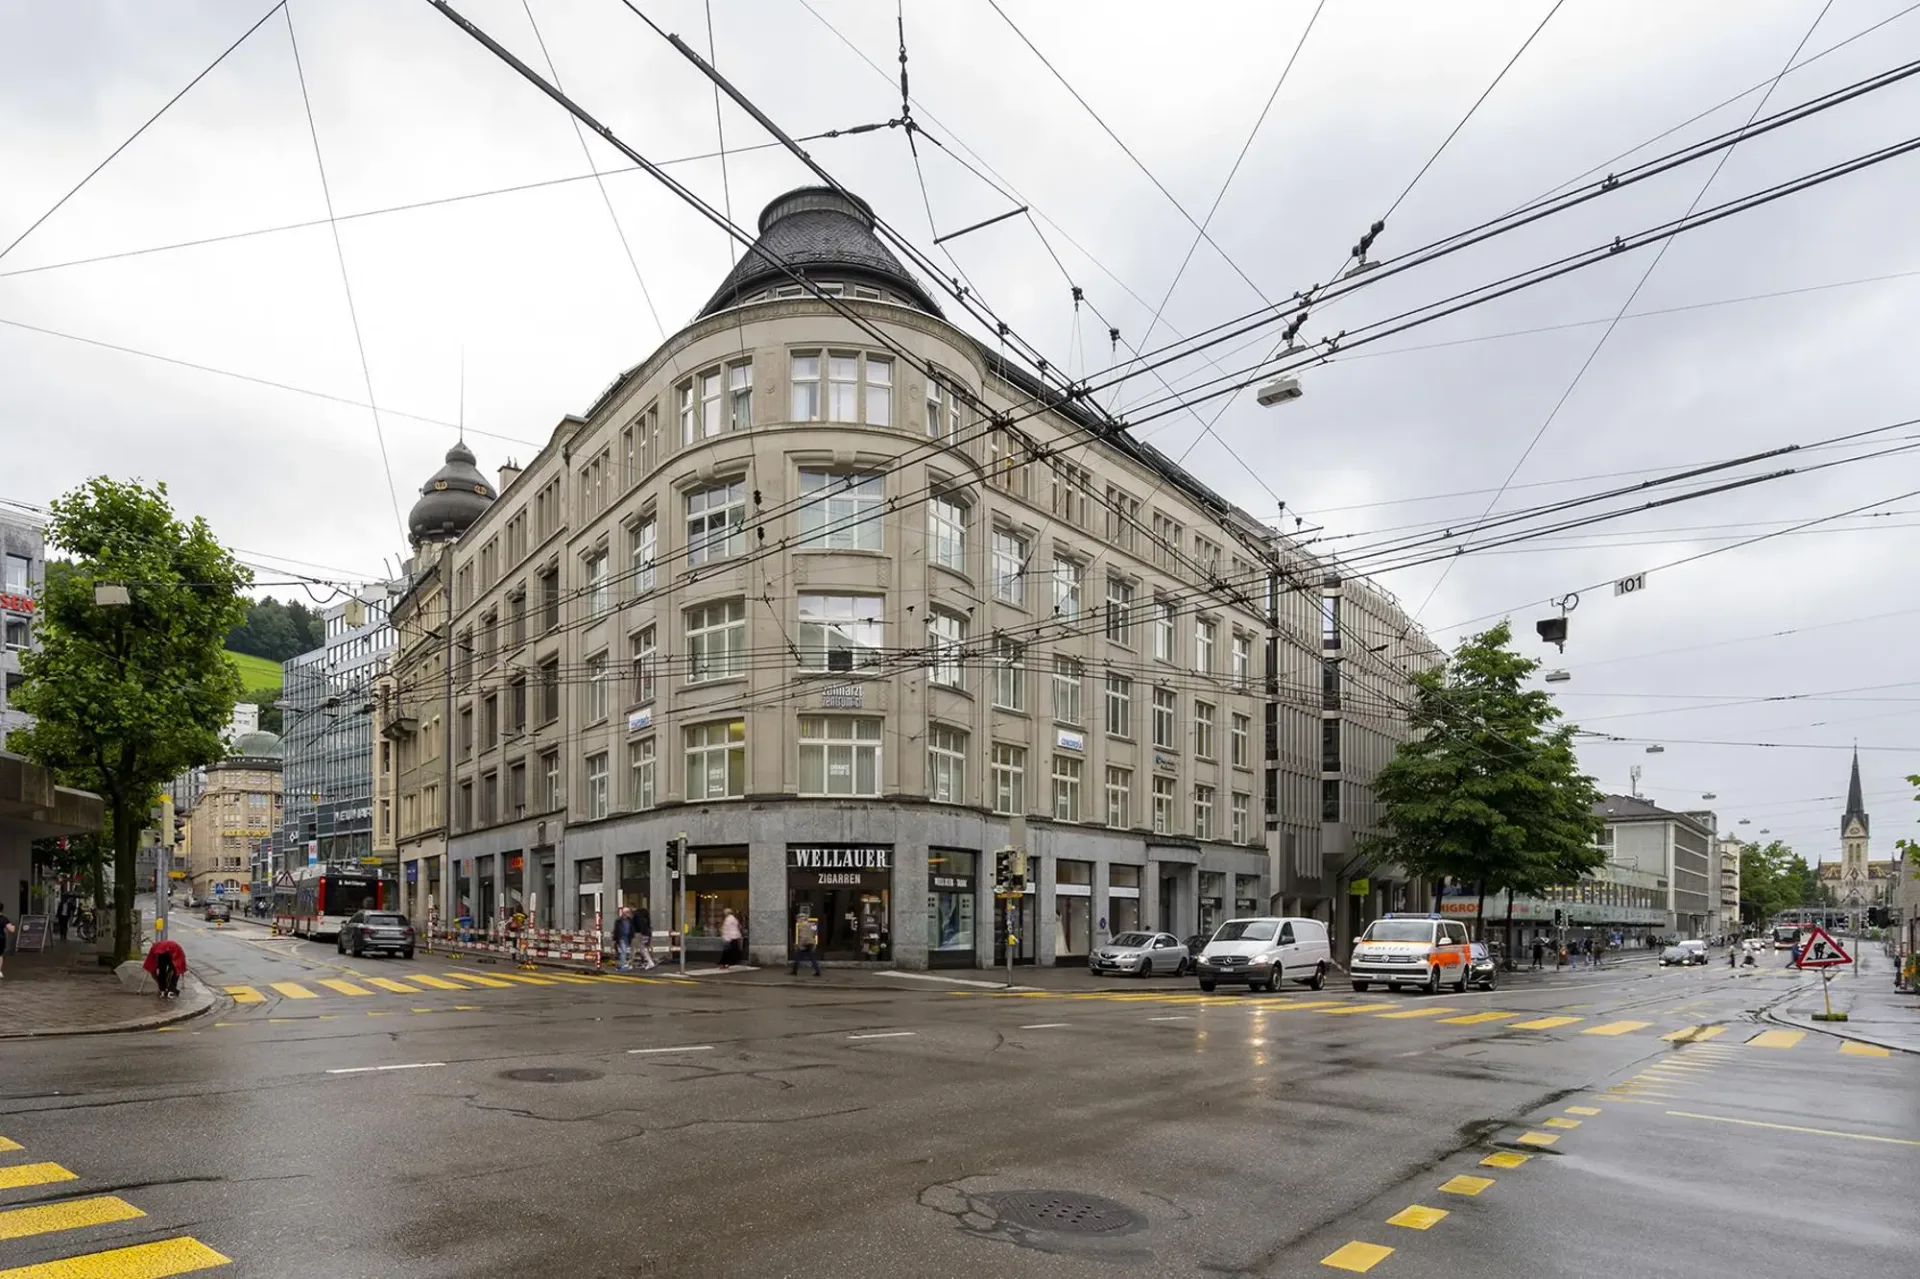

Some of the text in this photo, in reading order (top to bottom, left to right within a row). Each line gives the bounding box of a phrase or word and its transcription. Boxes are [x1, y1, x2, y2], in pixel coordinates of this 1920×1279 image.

[1618, 575, 1642, 594] 101
[795, 849, 886, 867] WELLAUER
[818, 873, 861, 884] ZIGARREN
